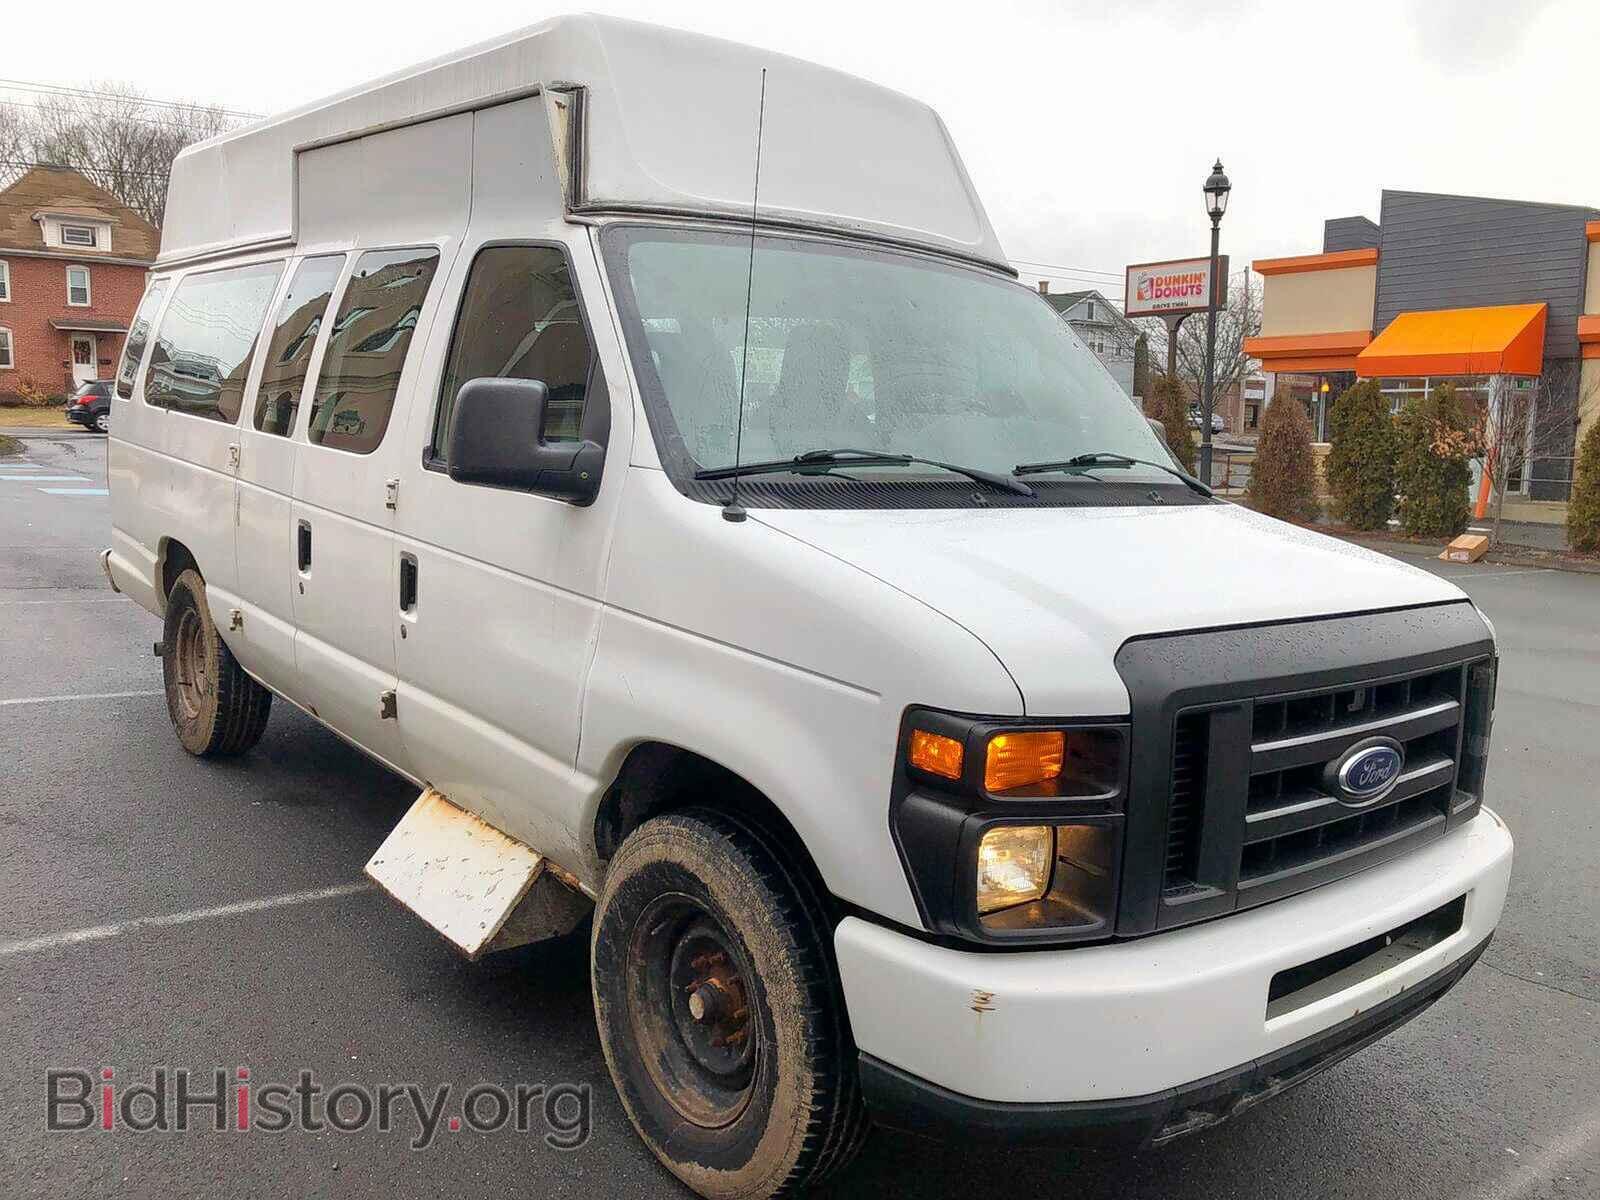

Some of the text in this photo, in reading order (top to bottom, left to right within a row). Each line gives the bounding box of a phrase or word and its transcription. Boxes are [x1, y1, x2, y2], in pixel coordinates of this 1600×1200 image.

[1155, 272, 1206, 287] DUNKIN'
[1154, 284, 1203, 299] DONUTS
[1359, 758, 1393, 786] Ford
